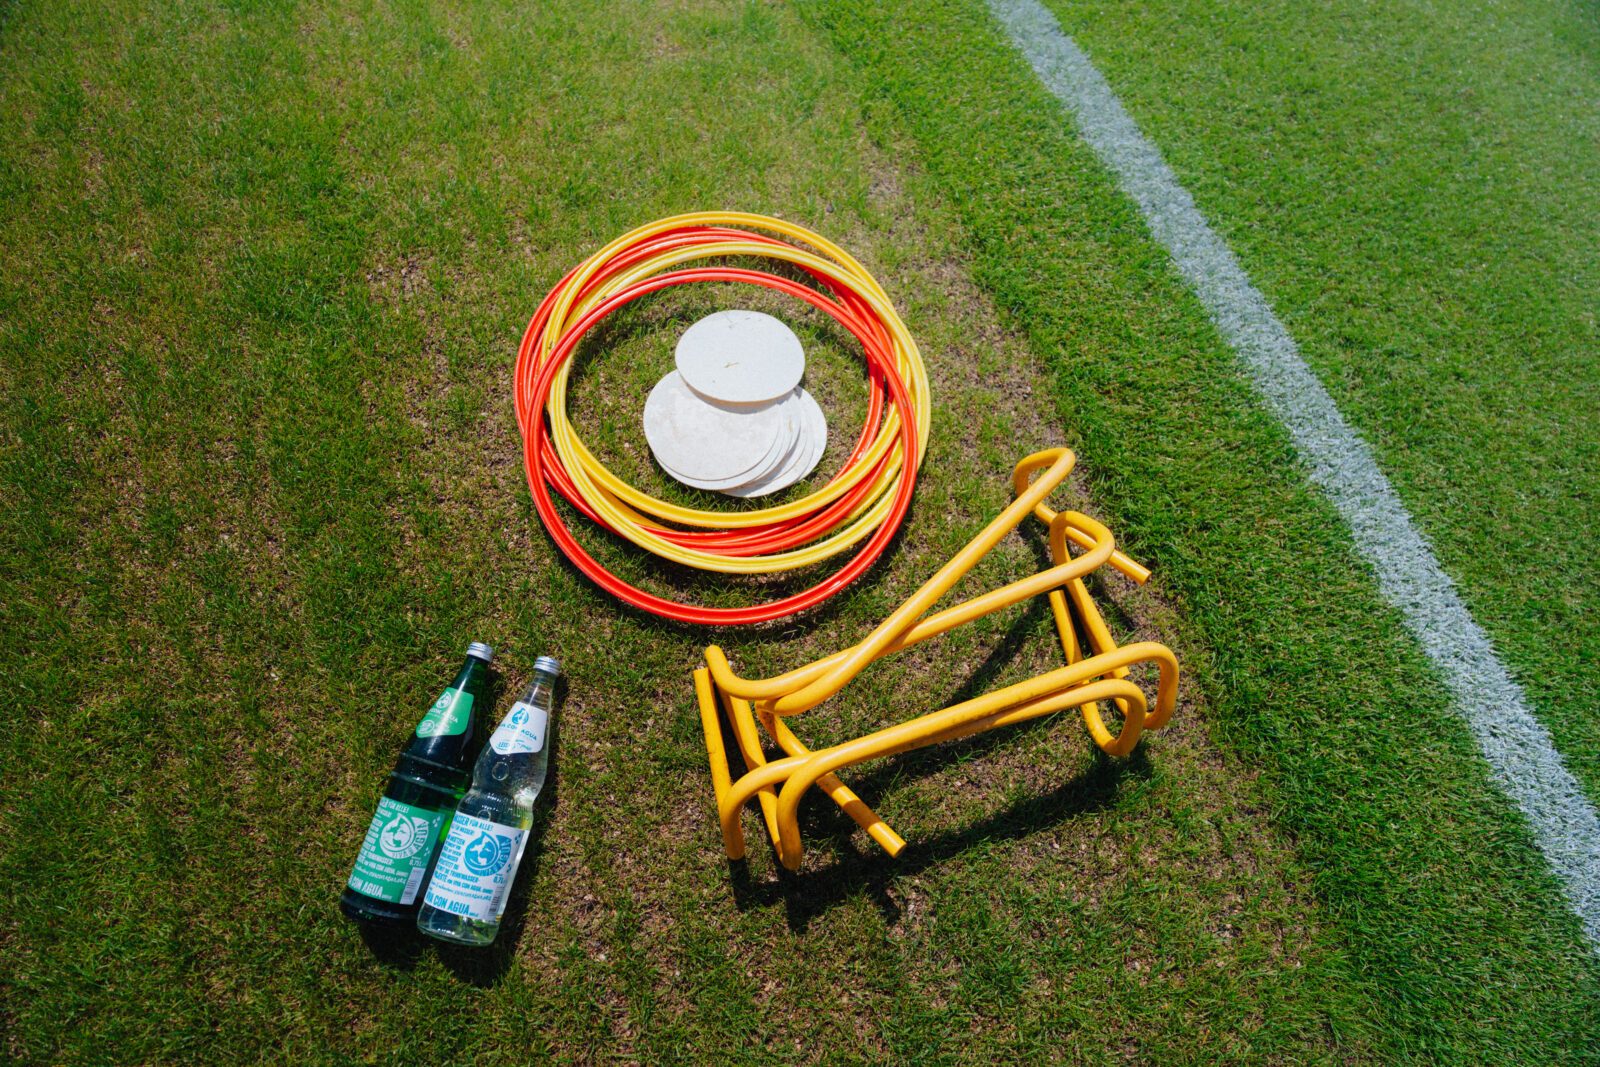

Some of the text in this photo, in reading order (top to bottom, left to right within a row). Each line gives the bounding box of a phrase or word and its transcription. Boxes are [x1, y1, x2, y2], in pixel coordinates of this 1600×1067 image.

[520, 728, 538, 741] AGUA
[479, 821, 494, 831] ALLE!
[362, 881, 383, 897] AGUA
[433, 895, 448, 909] CON
[447, 900, 470, 915] AGUA
